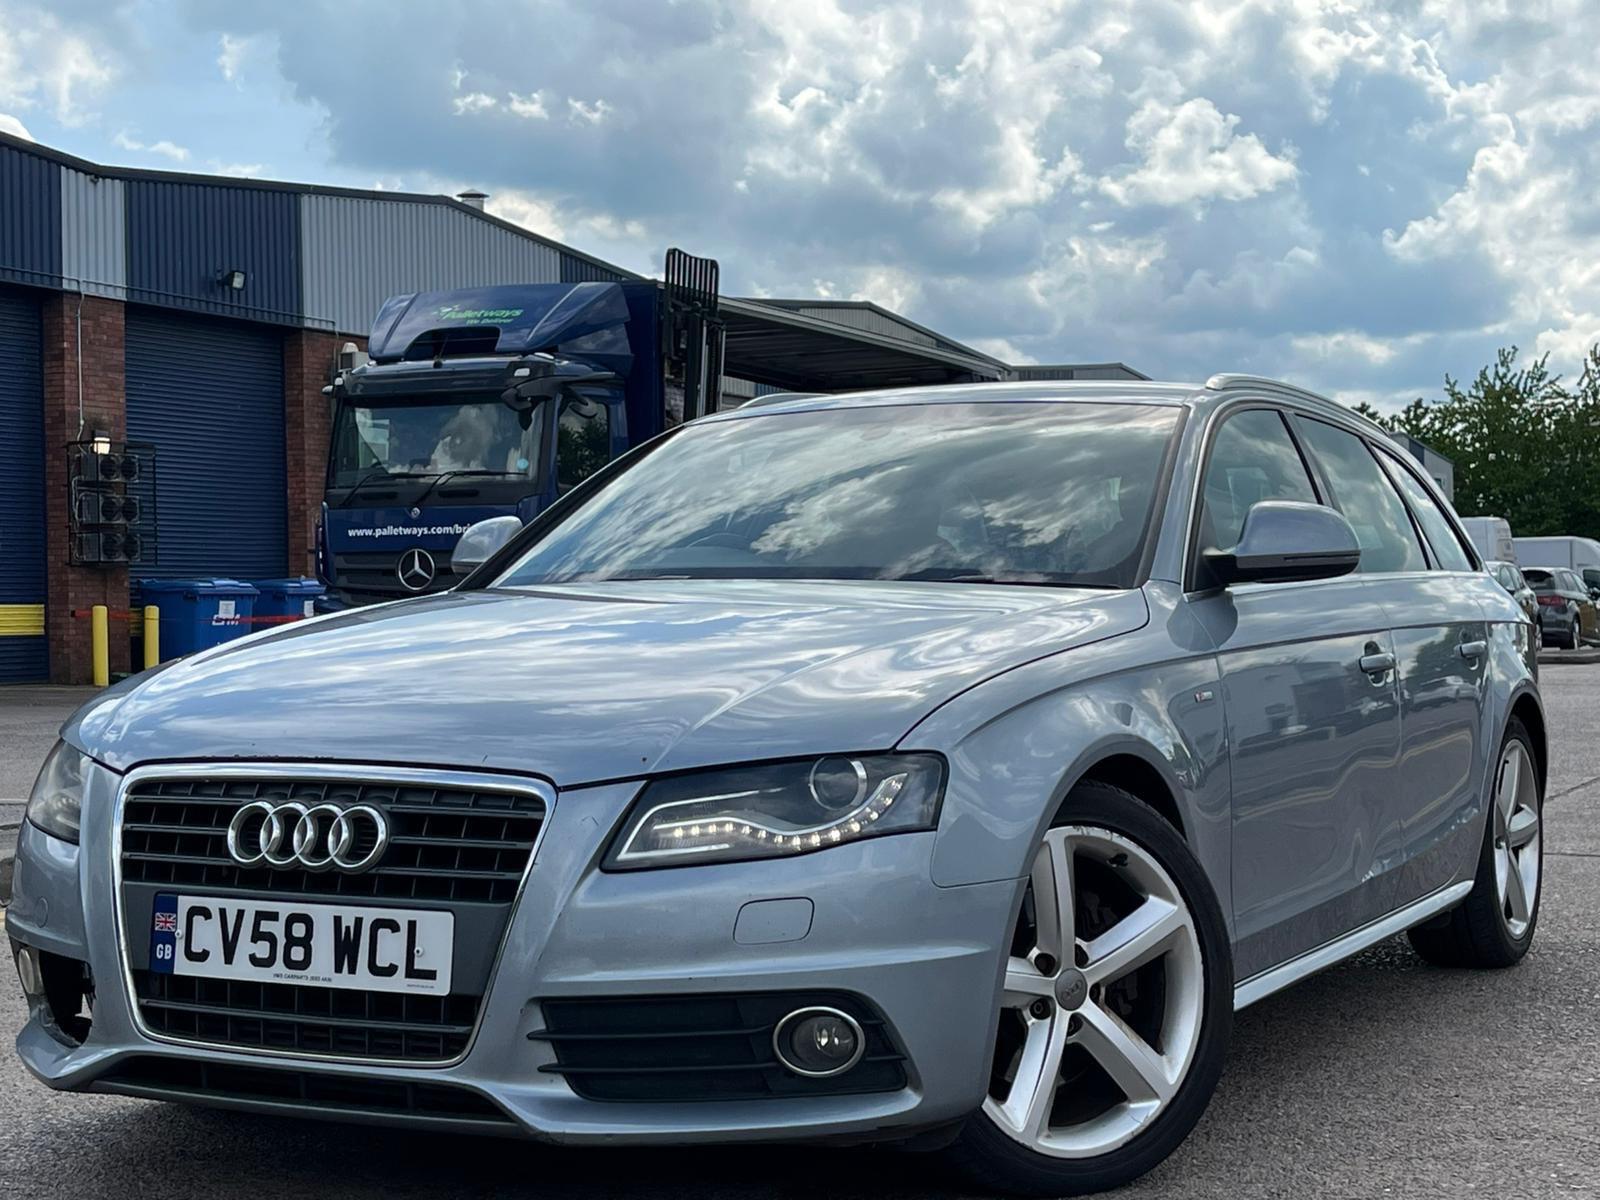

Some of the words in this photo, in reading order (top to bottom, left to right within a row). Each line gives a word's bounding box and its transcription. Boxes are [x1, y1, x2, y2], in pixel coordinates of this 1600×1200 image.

[156, 943, 172, 960] GB
[183, 905, 314, 971] CV58
[333, 915, 437, 981] WCL
